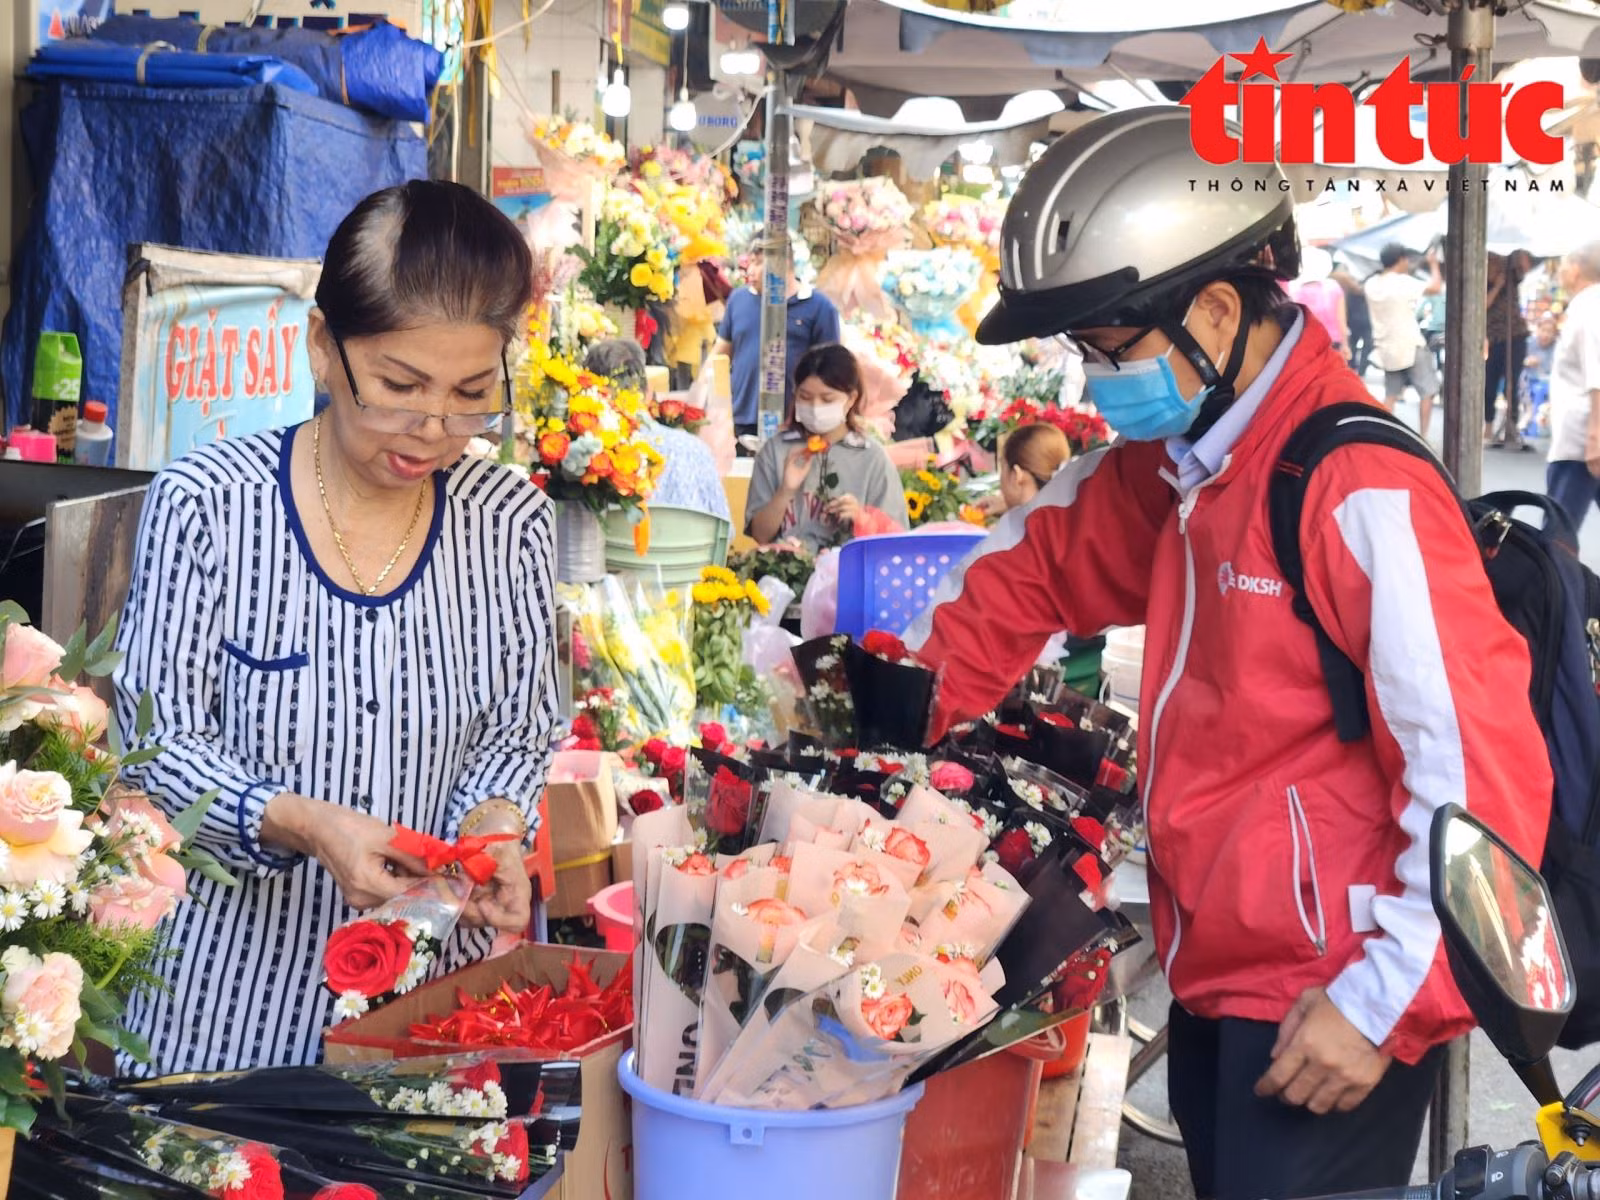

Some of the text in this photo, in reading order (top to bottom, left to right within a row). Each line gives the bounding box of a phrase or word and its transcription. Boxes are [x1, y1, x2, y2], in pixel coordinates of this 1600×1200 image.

[165, 296, 299, 416] GIẶT SẤY
[1238, 574, 1282, 597] DKSH
